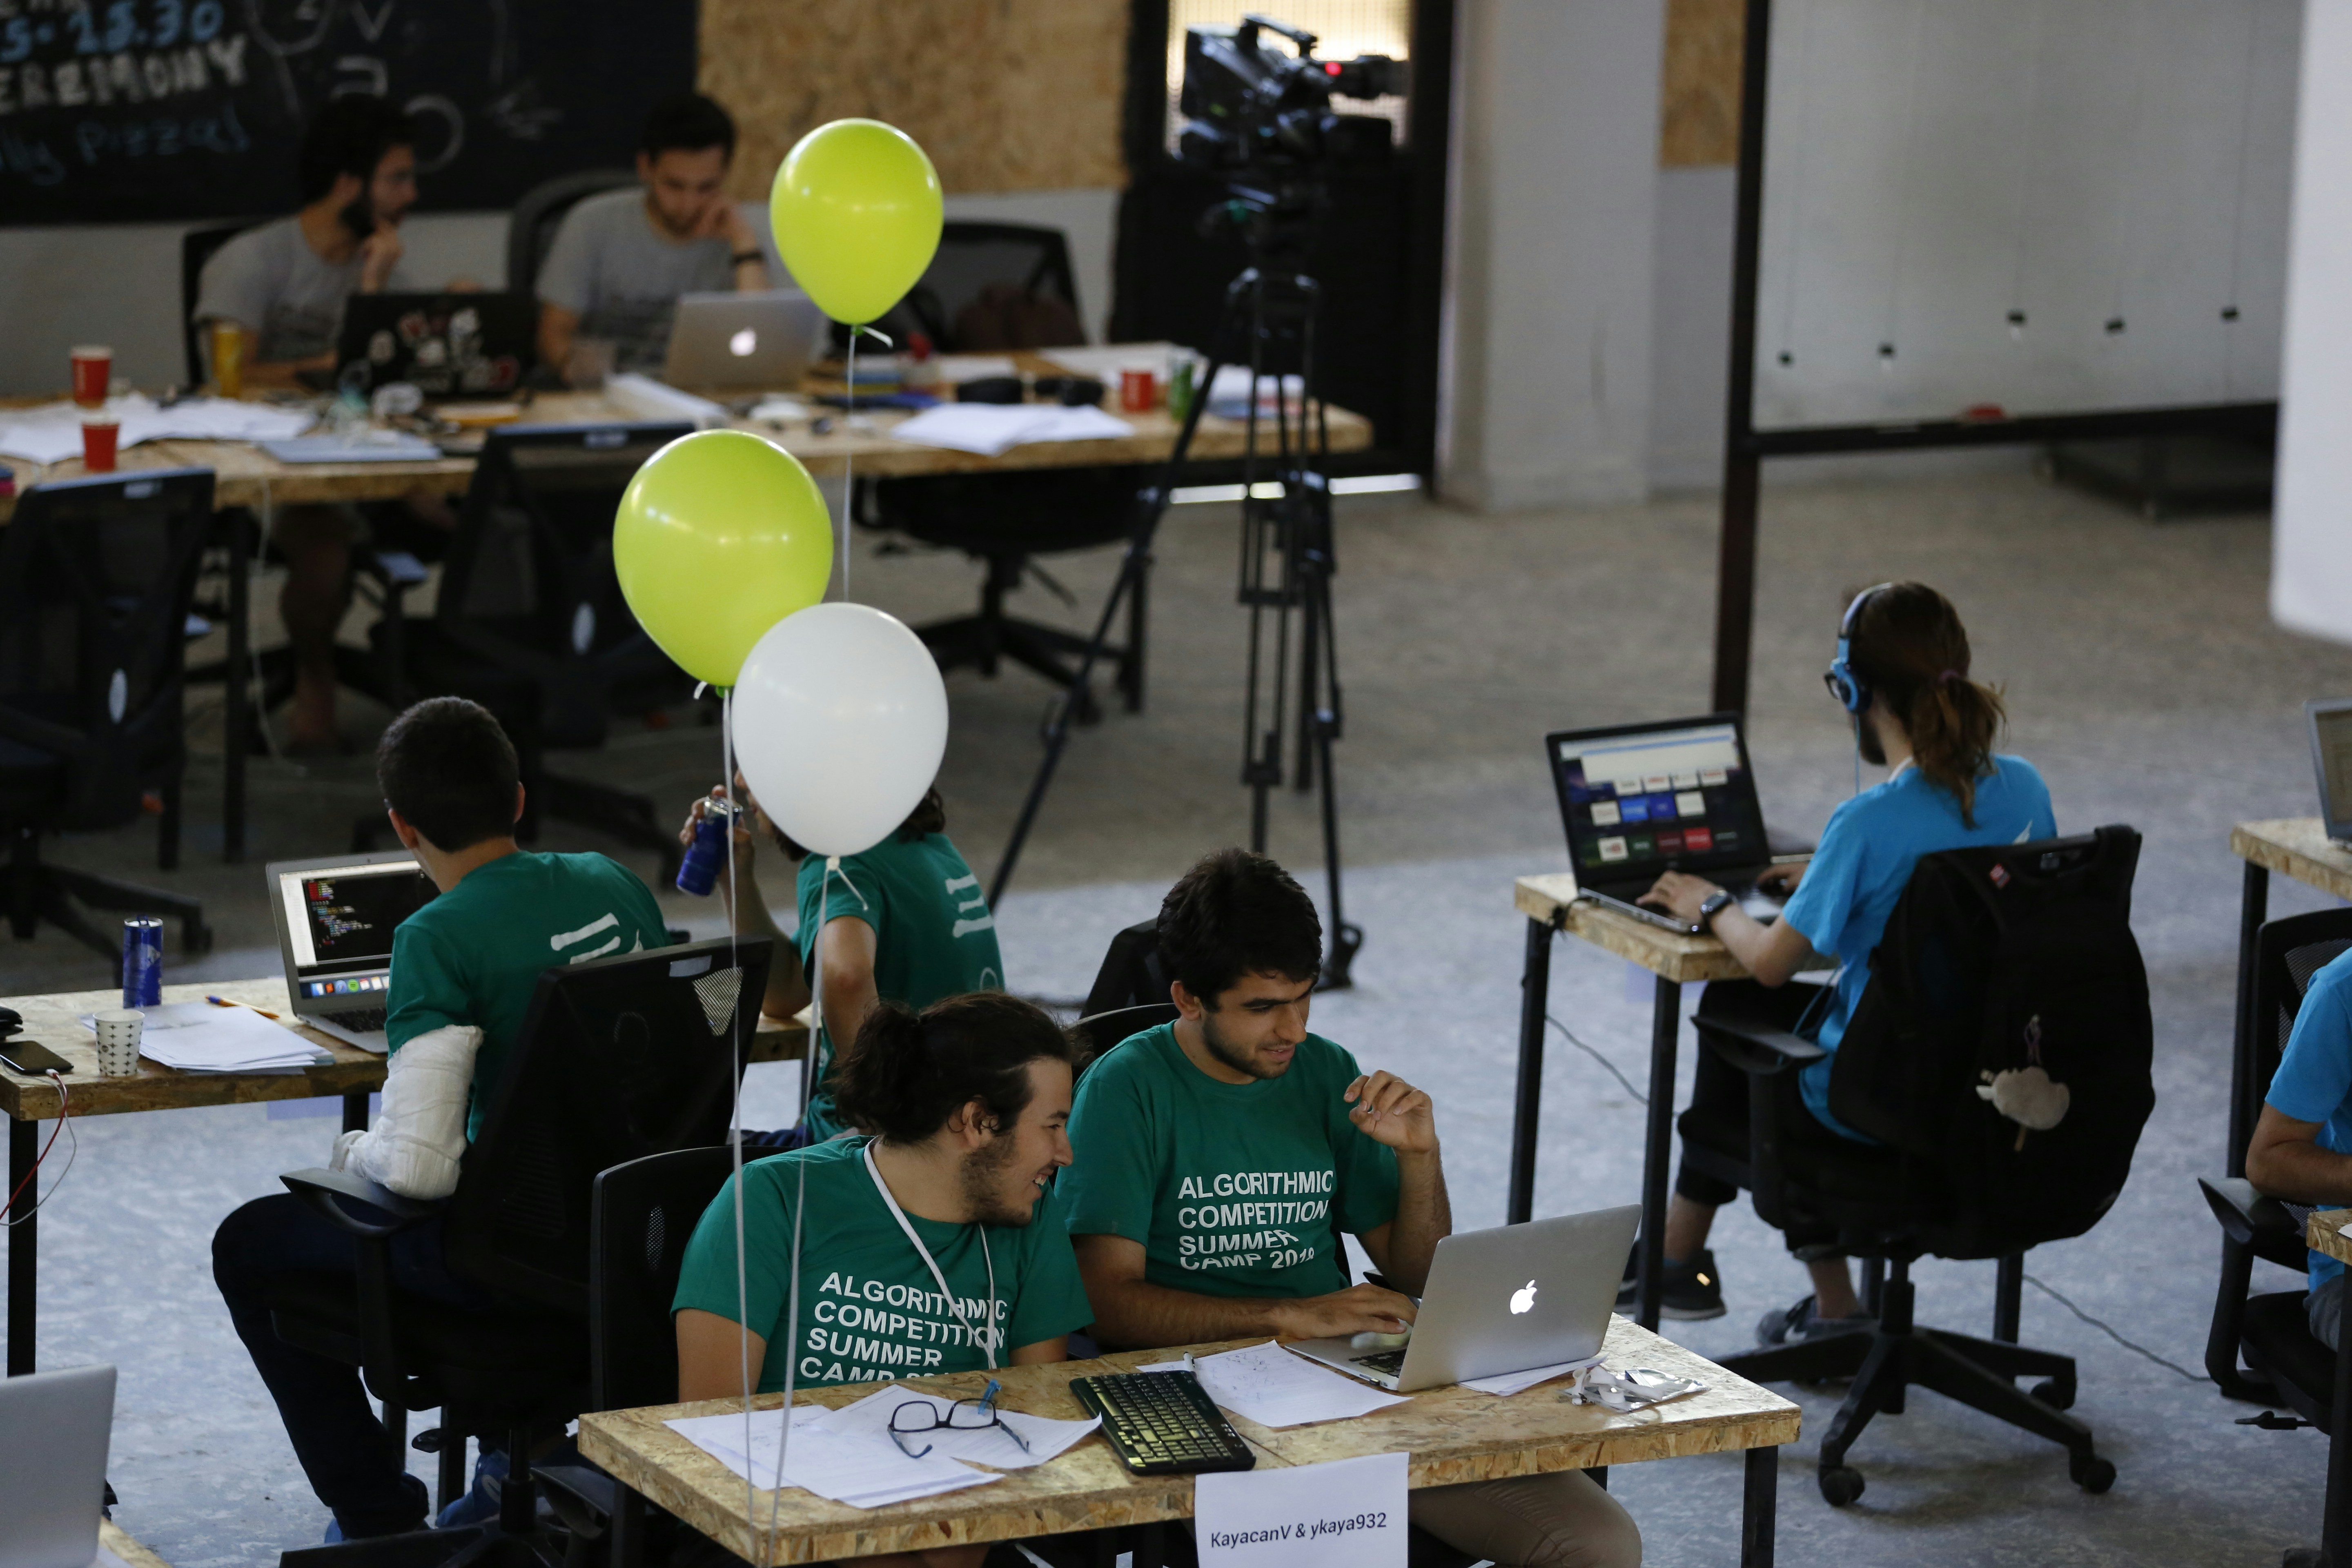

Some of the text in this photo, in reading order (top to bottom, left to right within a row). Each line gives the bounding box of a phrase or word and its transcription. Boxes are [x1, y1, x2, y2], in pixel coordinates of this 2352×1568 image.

[1178, 1170, 1334, 1199] ALGORITHMIC
[1178, 1200, 1329, 1228] COMPETITION
[1179, 1229, 1298, 1255] SUMMER
[1180, 1253, 1261, 1270] CAMP
[819, 1272, 1008, 1320] ALGORITHMC
[815, 1301, 1004, 1348] COMPETITION
[807, 1328, 942, 1366] SUMMER
[1211, 1512, 1387, 1549] KayacanV & ykaya932
